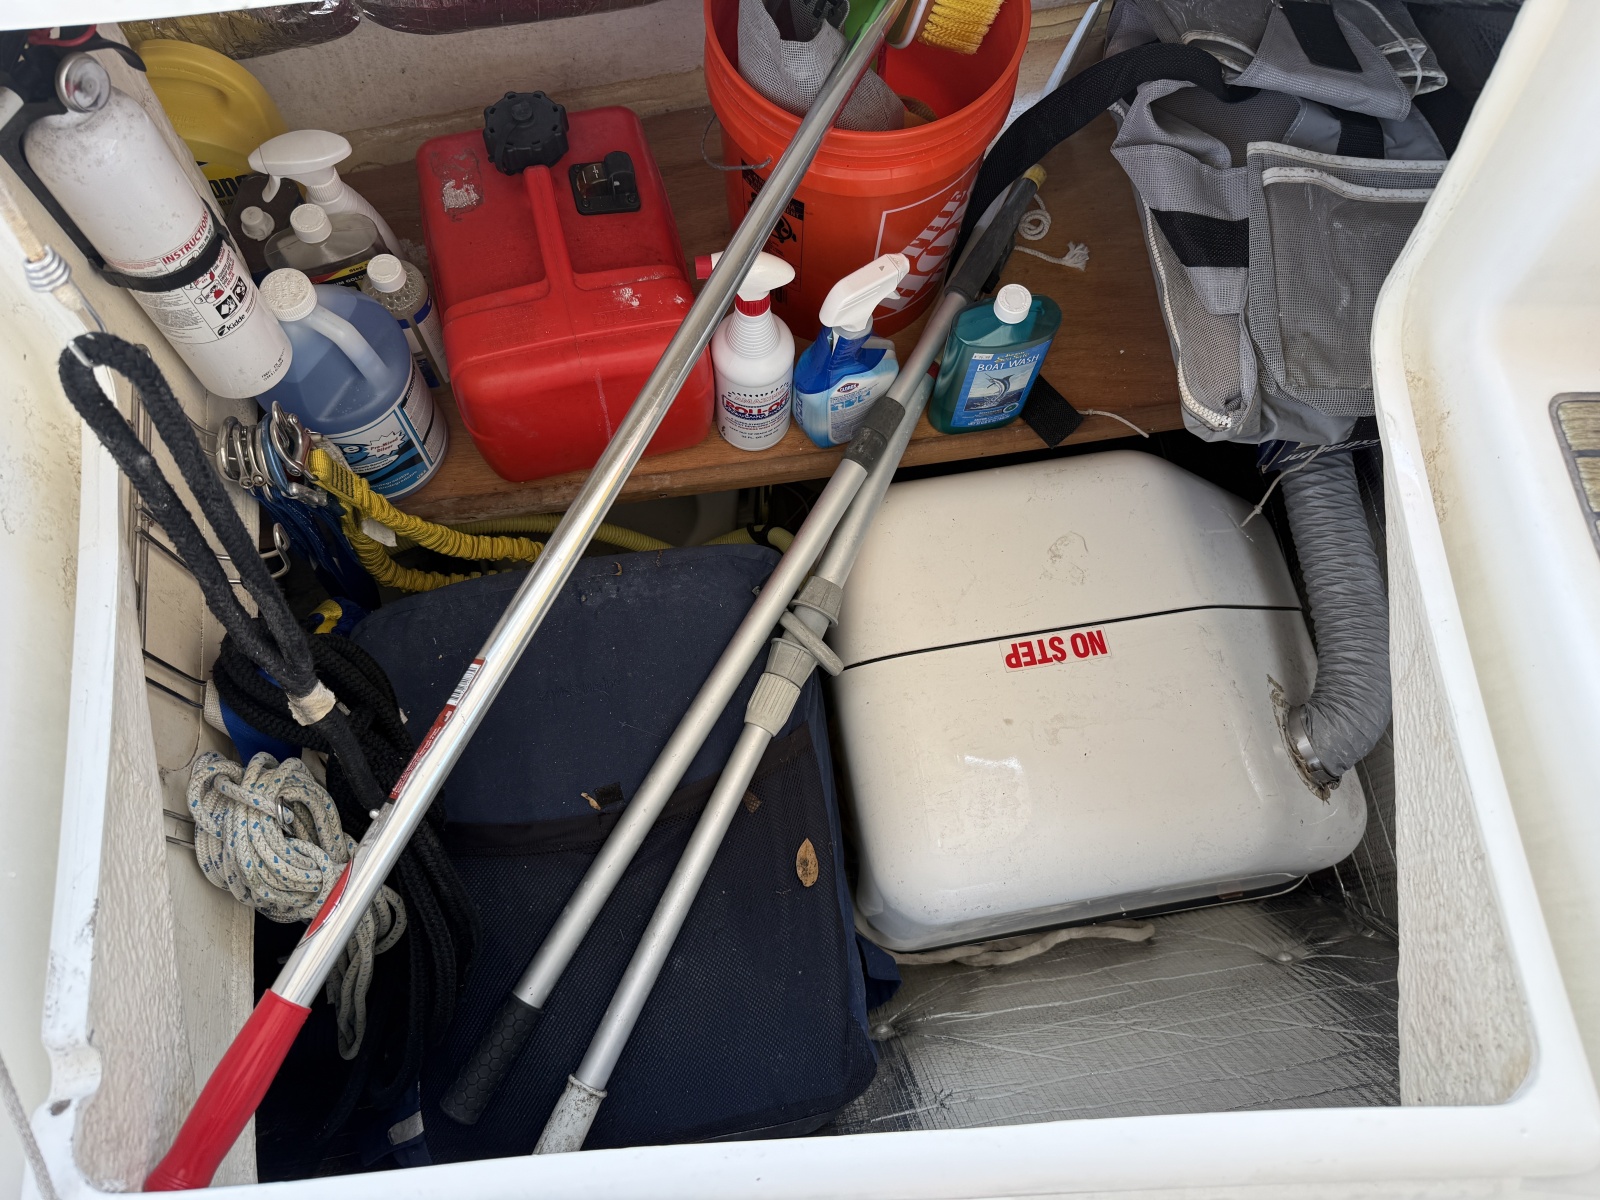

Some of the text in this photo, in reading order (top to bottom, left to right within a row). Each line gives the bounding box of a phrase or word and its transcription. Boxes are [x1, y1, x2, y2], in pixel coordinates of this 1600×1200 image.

[900, 190, 968, 259] THE
[226, 314, 246, 331] Kidde
[976, 362, 1007, 372] BOAT
[1009, 353, 1040, 368] WASH
[839, 383, 858, 393] CLOROX
[1005, 629, 1108, 669] NO STEP
